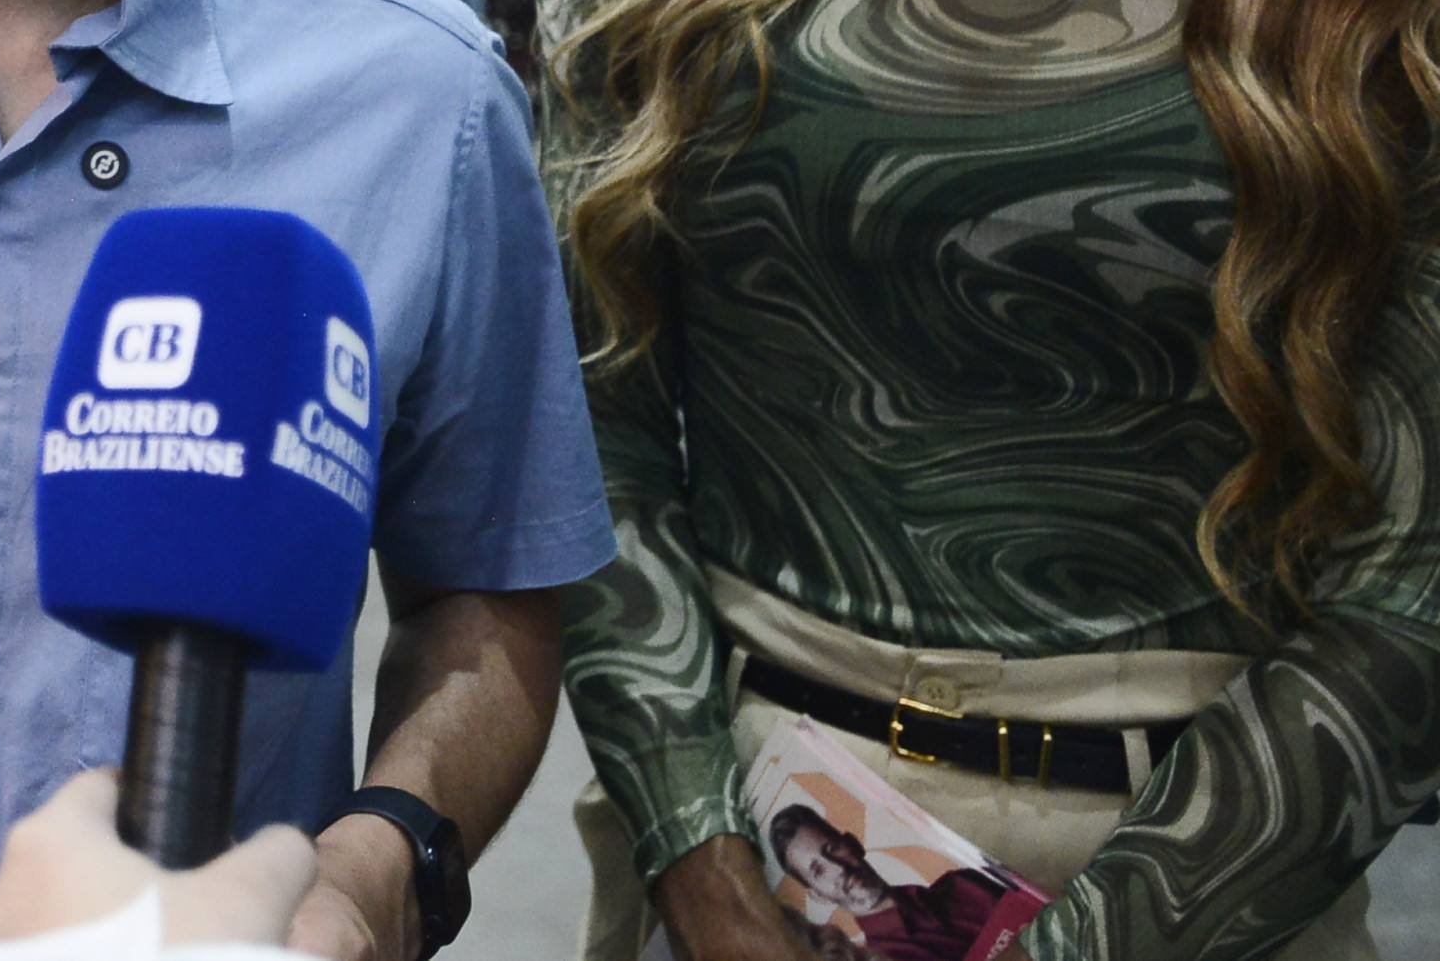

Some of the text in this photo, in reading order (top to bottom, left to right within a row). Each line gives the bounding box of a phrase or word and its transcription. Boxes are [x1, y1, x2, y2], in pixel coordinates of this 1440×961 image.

[114, 324, 182, 364] CB
[333, 344, 366, 400] CB
[65, 392, 220, 437] CORREIO
[42, 430, 246, 479] BRAZILIENSE
